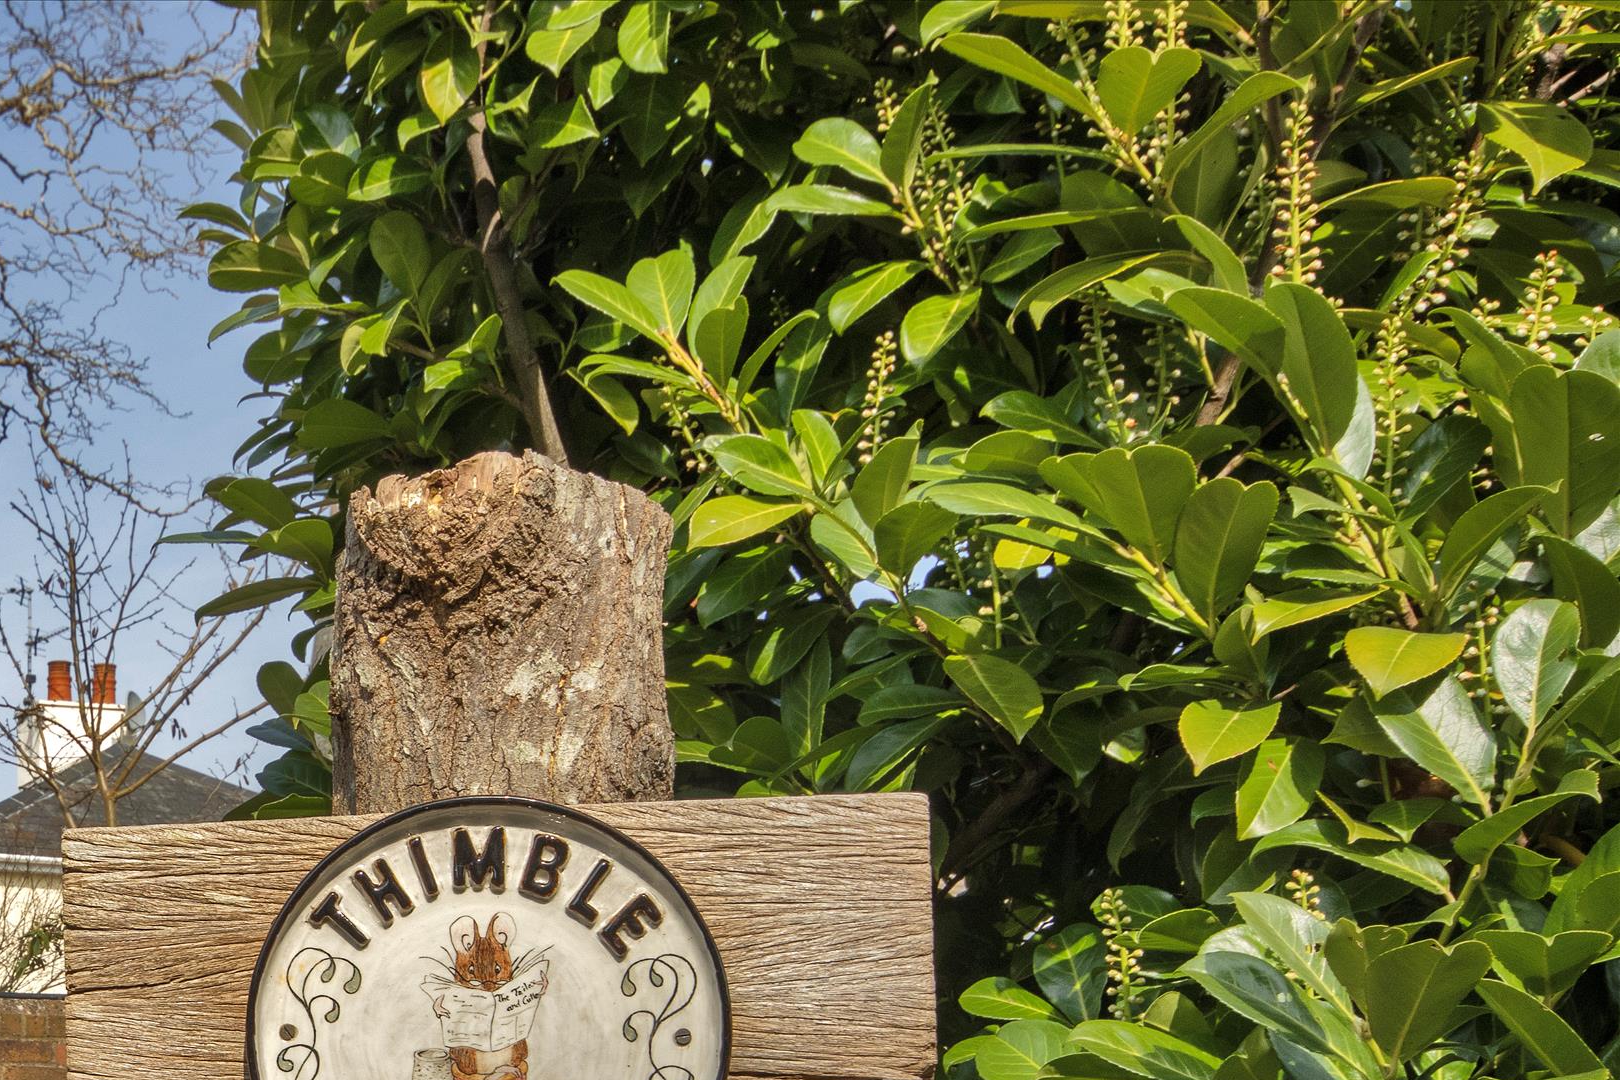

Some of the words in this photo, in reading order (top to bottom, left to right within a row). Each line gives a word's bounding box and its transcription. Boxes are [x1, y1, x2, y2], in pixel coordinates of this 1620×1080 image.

[307, 824, 665, 962] THIMBLE
[494, 993, 510, 1003] The
[506, 999, 521, 1012] and
